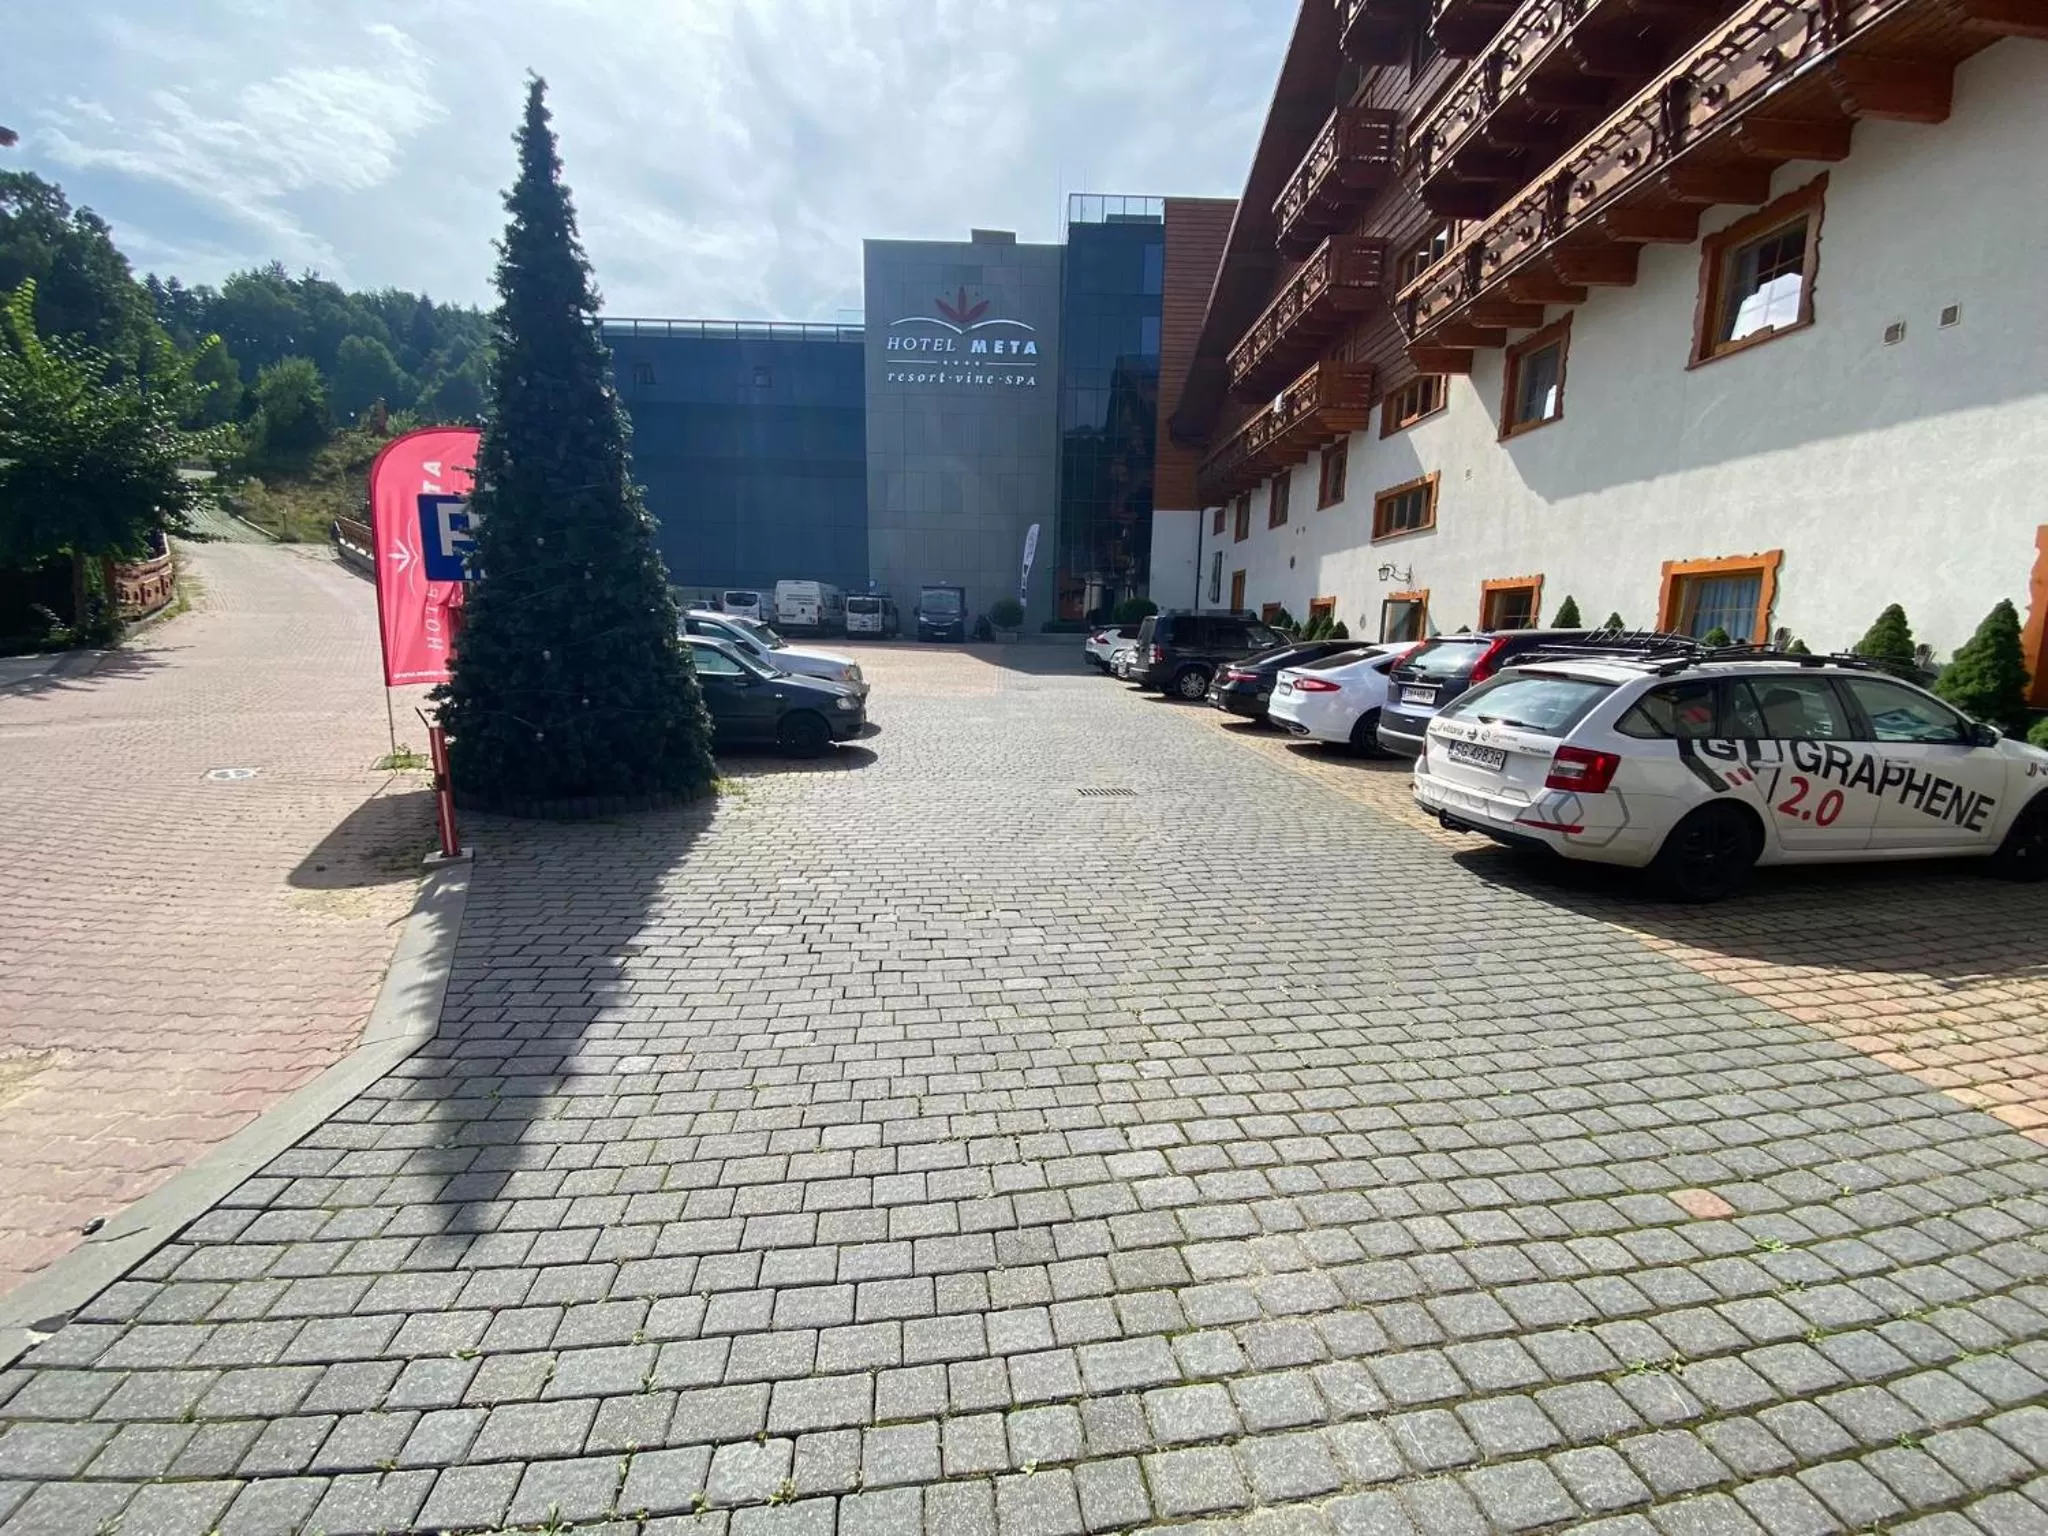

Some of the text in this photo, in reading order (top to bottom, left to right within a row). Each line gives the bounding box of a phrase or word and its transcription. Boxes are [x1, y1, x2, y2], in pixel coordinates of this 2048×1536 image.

[887, 337, 1037, 354] HOTEL META
[1777, 775, 1845, 827] 2.0
[1790, 738, 1996, 834] GRAPHENE
